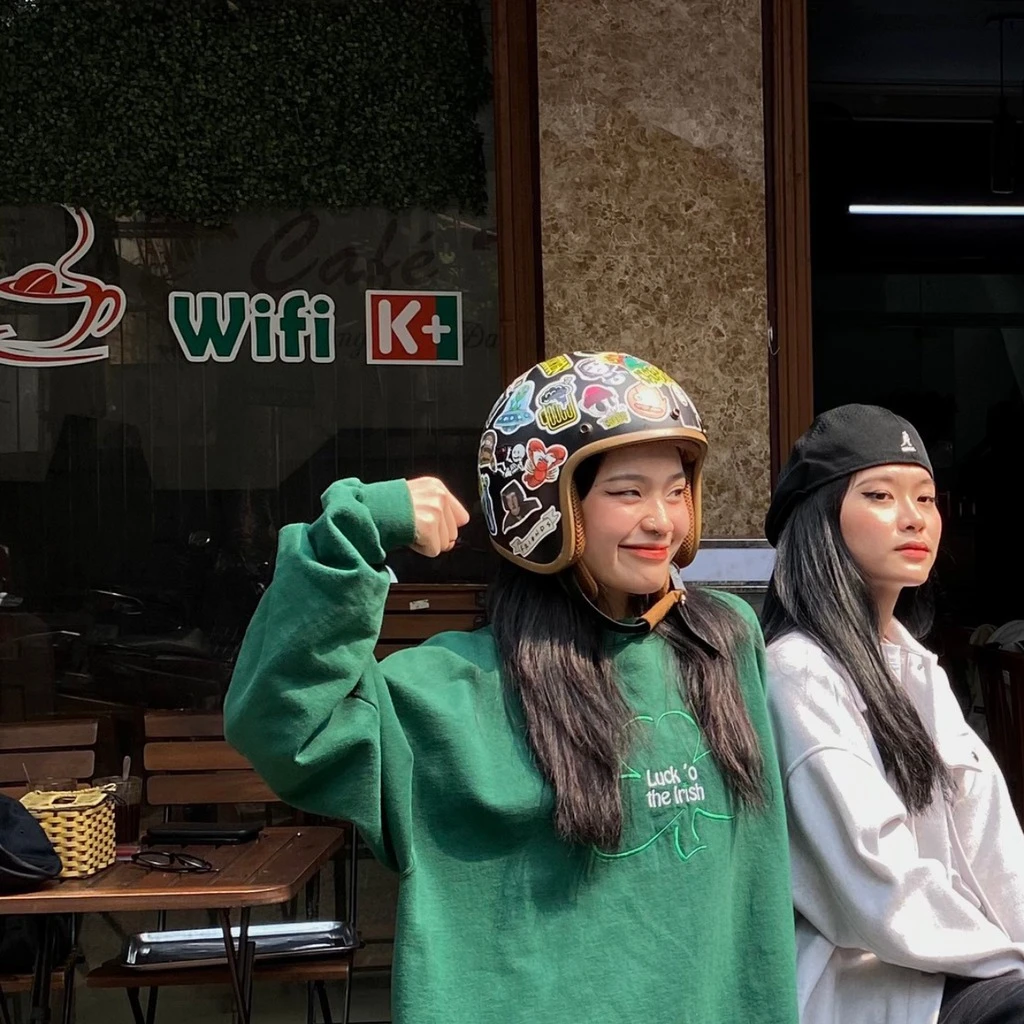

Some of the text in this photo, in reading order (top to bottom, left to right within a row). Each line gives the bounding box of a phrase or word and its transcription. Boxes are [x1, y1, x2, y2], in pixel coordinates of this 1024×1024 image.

[169, 291, 335, 363] Wifi
[376, 298, 452, 356] K+
[646, 765, 682, 787] Luck
[646, 783, 705, 808] the Irish
